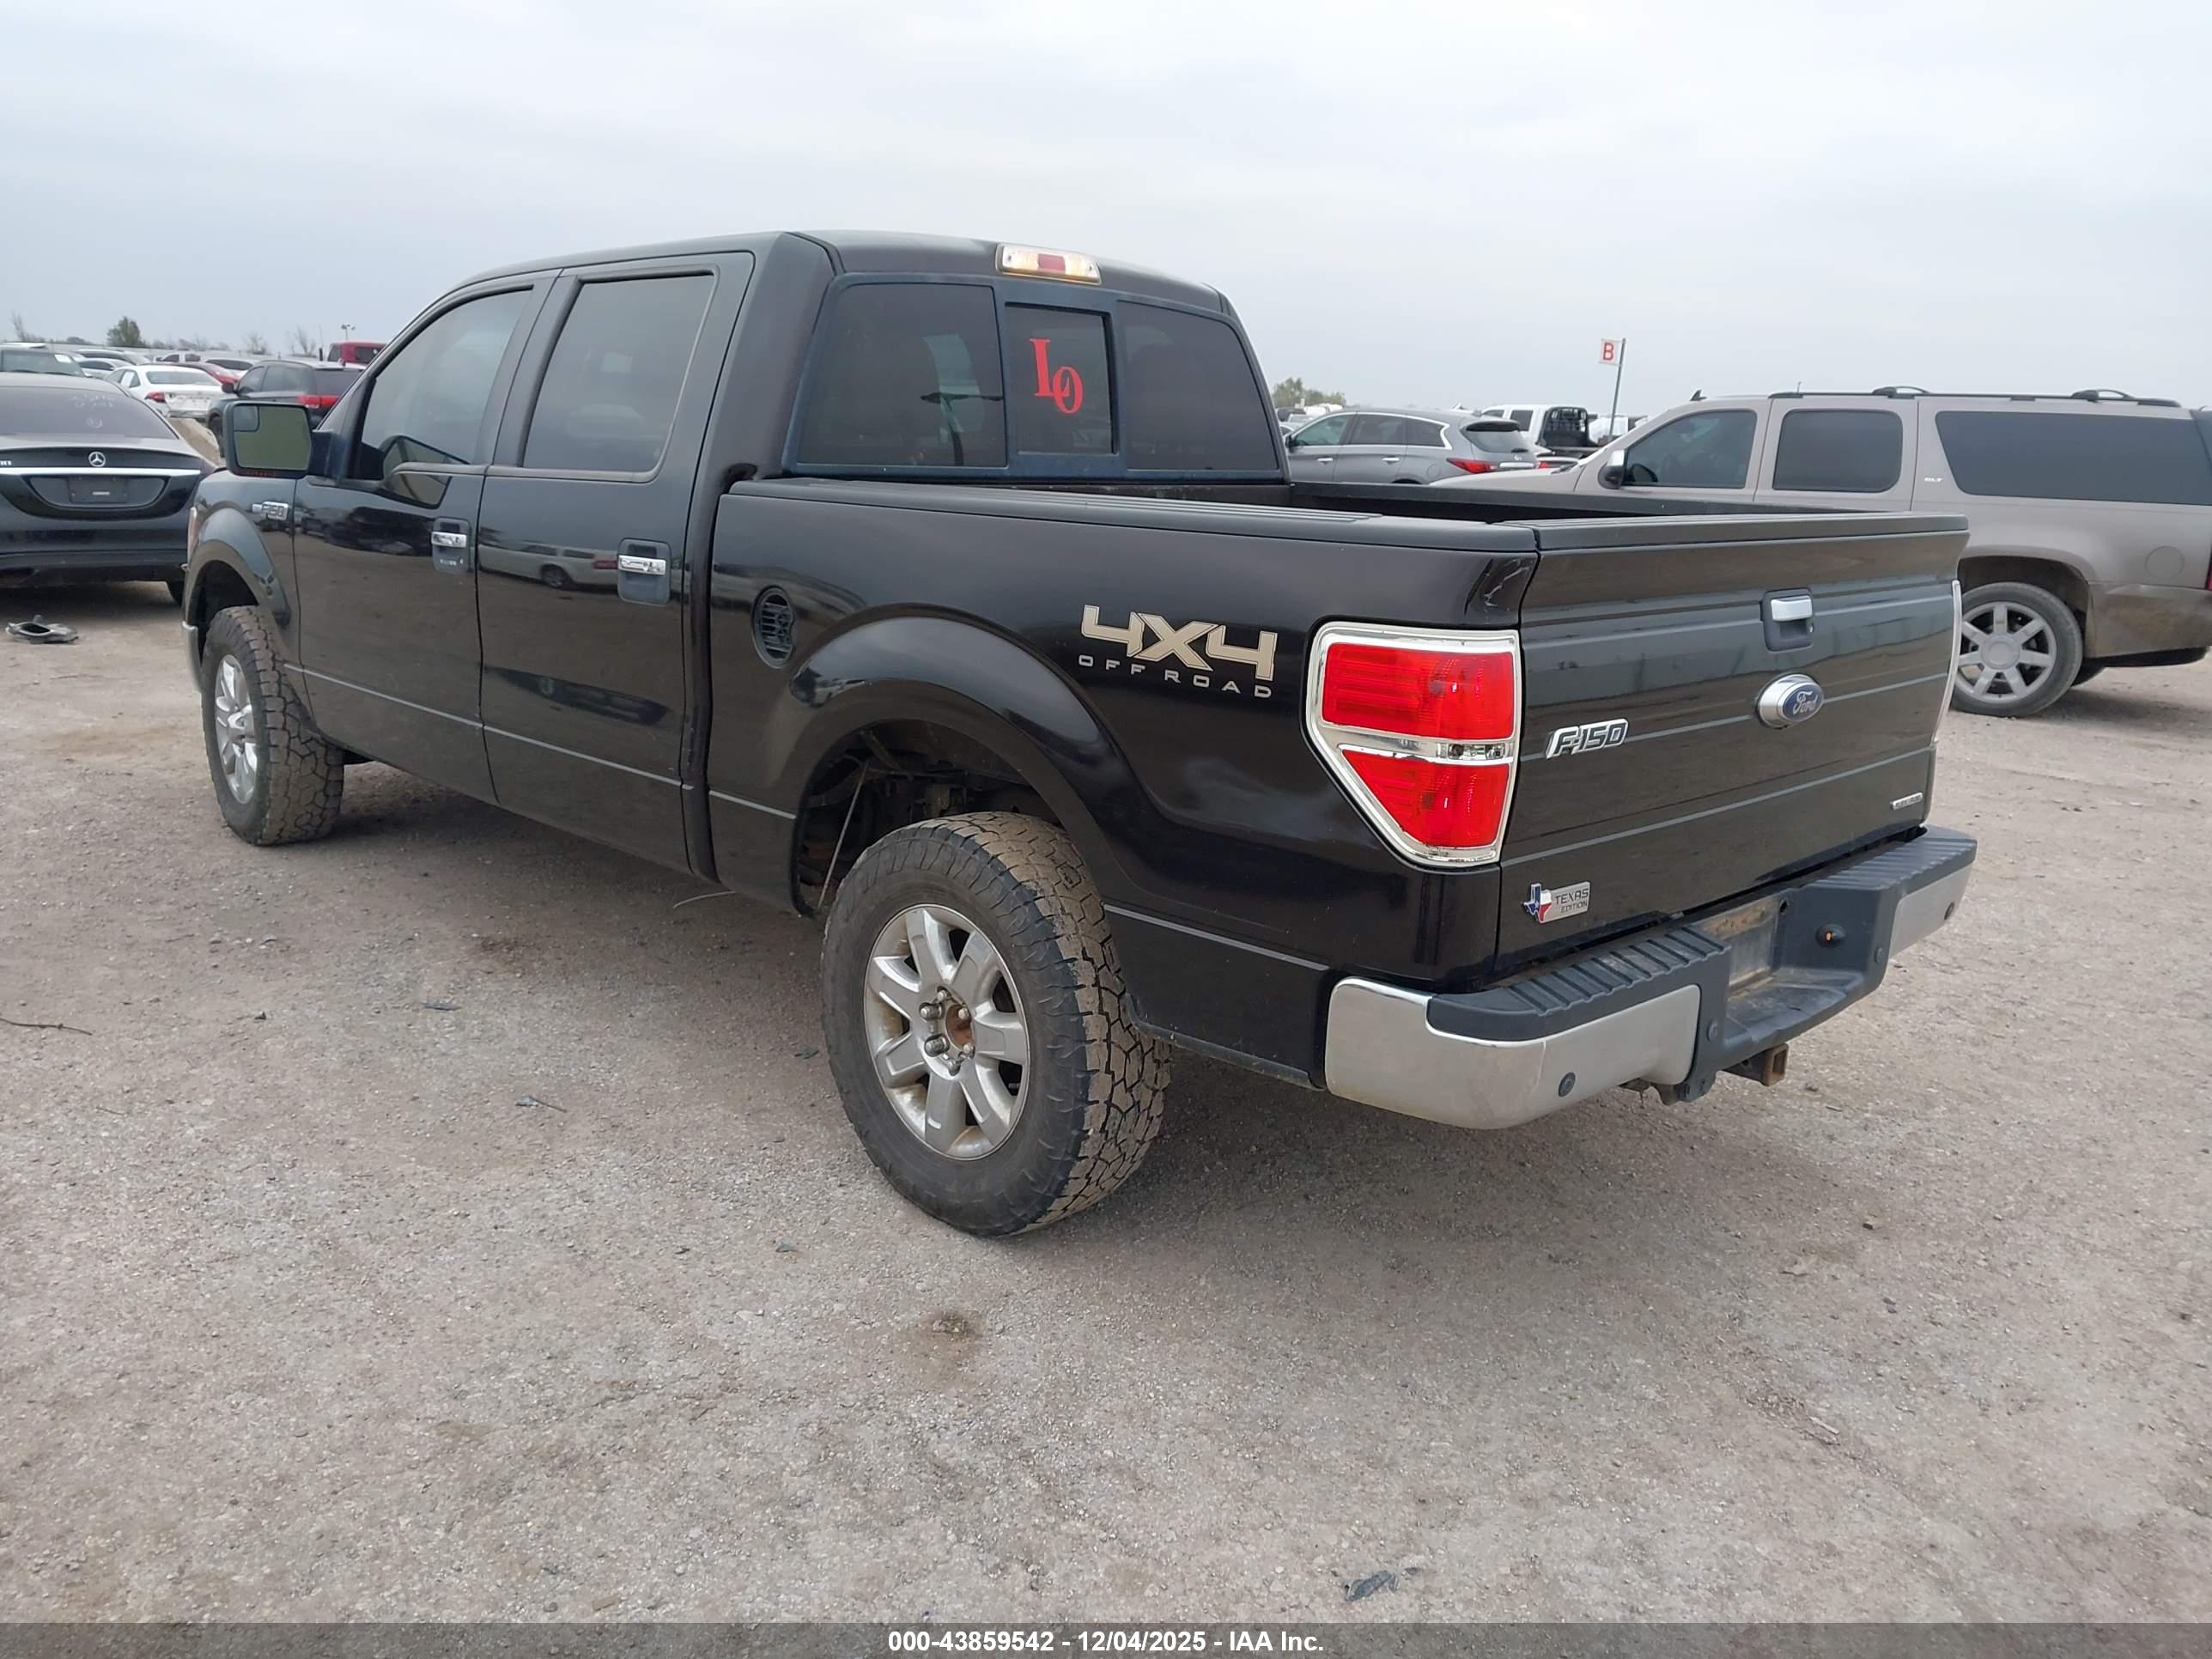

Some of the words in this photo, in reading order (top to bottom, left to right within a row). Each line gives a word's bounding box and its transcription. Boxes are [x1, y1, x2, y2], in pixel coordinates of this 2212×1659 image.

[1603, 342, 1614, 361] B
[1079, 654, 1146, 675] OFF
[1164, 670, 1272, 697] ROAD
[1792, 690, 1819, 715] Ford
[1555, 888, 1589, 905] TEXAS
[1560, 900, 1588, 914] EDITION
